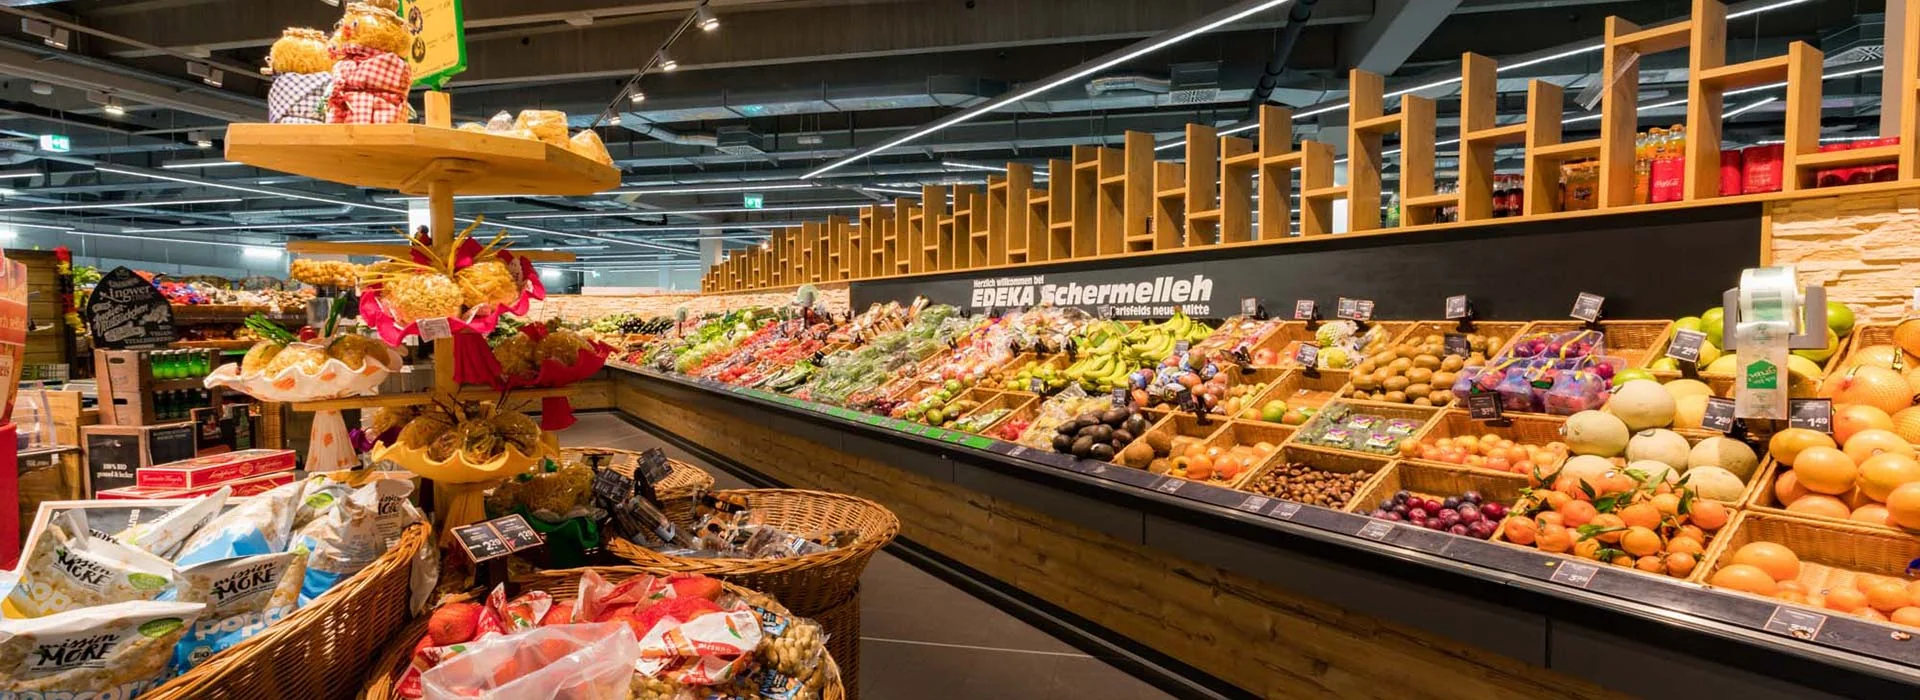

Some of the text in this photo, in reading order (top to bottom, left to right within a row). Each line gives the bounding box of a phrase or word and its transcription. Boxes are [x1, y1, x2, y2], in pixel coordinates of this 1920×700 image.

[971, 274, 1213, 307] EDEKA Schermelleh
[973, 274, 1045, 288] Herzlich willkommen bei
[109, 286, 151, 304] Ingwer
[1153, 306, 1176, 316] neue
[1182, 305, 1210, 316] Mitte
[214, 561, 278, 588] mission
[215, 568, 277, 600] MORE
[38, 633, 120, 651] mission
[38, 642, 118, 666] MORE
